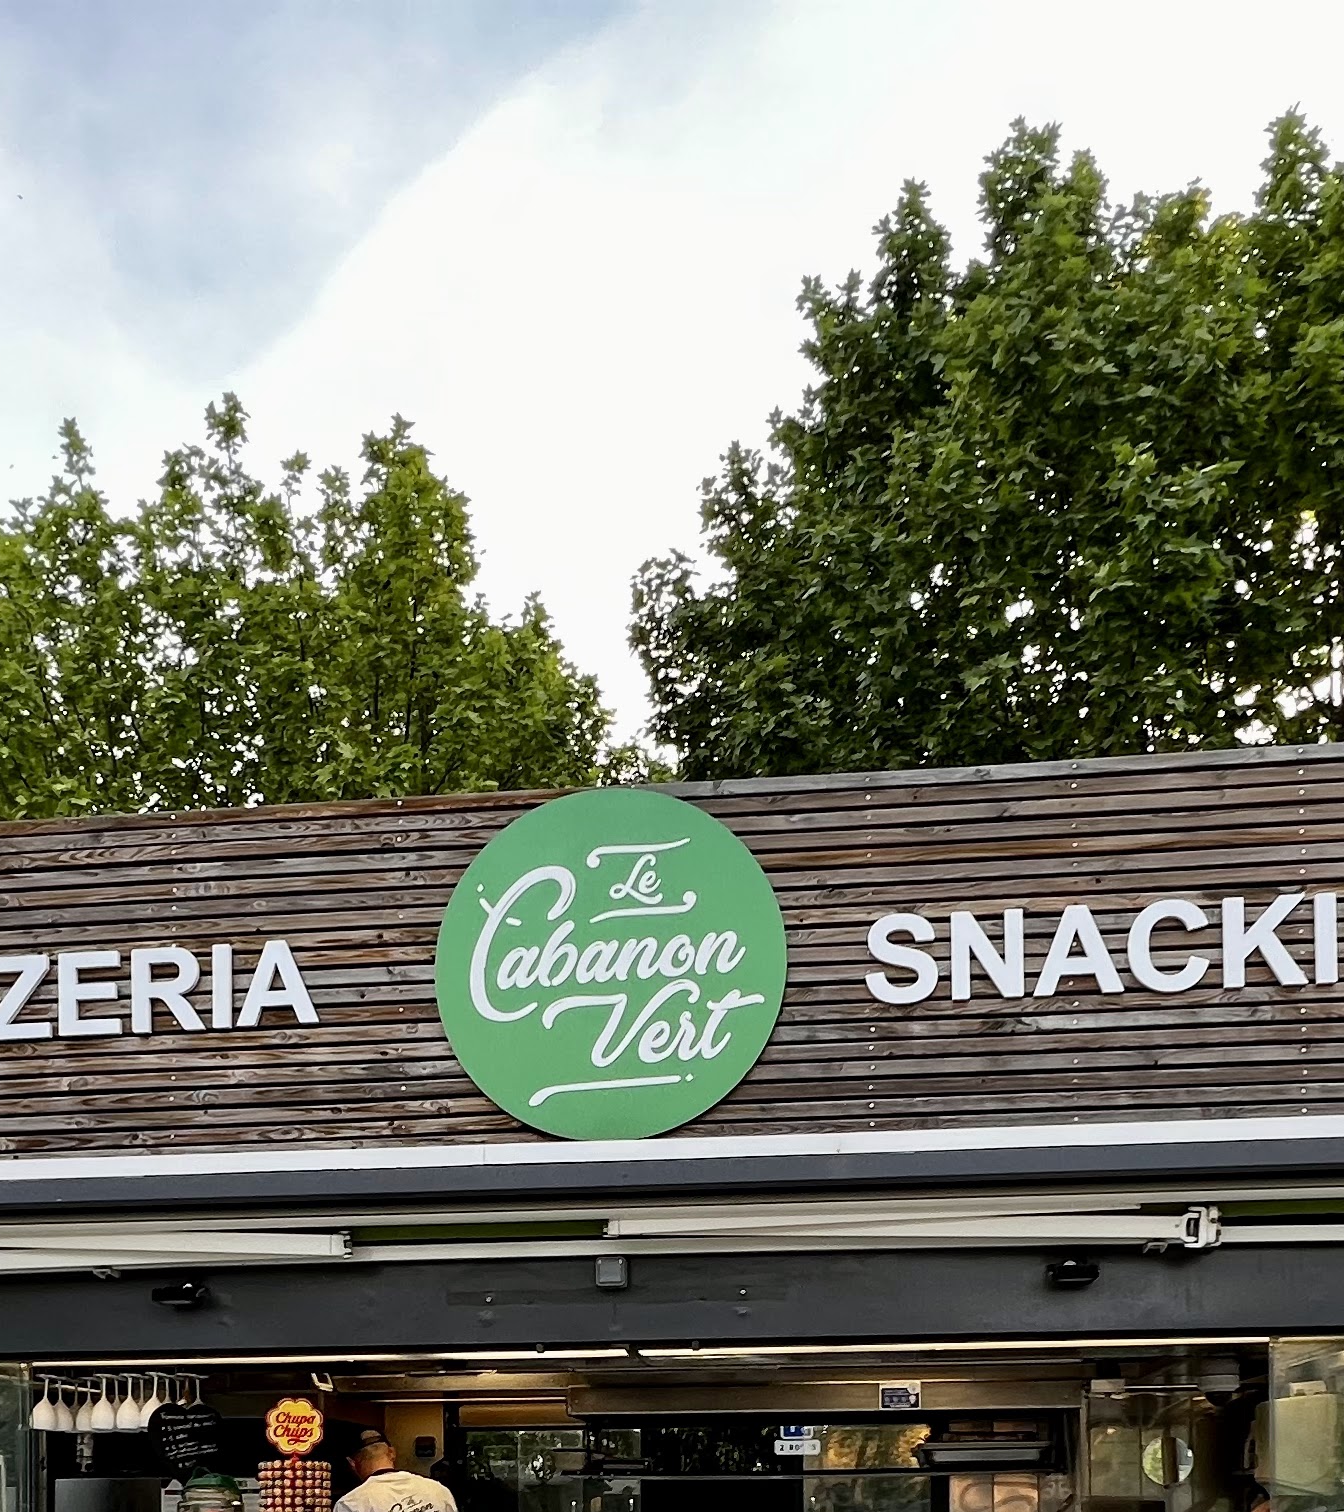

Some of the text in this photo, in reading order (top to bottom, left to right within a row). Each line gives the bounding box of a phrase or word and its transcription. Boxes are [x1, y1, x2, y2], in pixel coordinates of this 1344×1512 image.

[608, 852, 663, 905] Le
[469, 864, 746, 1023] Cabanon
[542, 978, 765, 1068] Vert
[273, 1424, 315, 1445] Chups
[276, 1411, 316, 1428] Chupa
